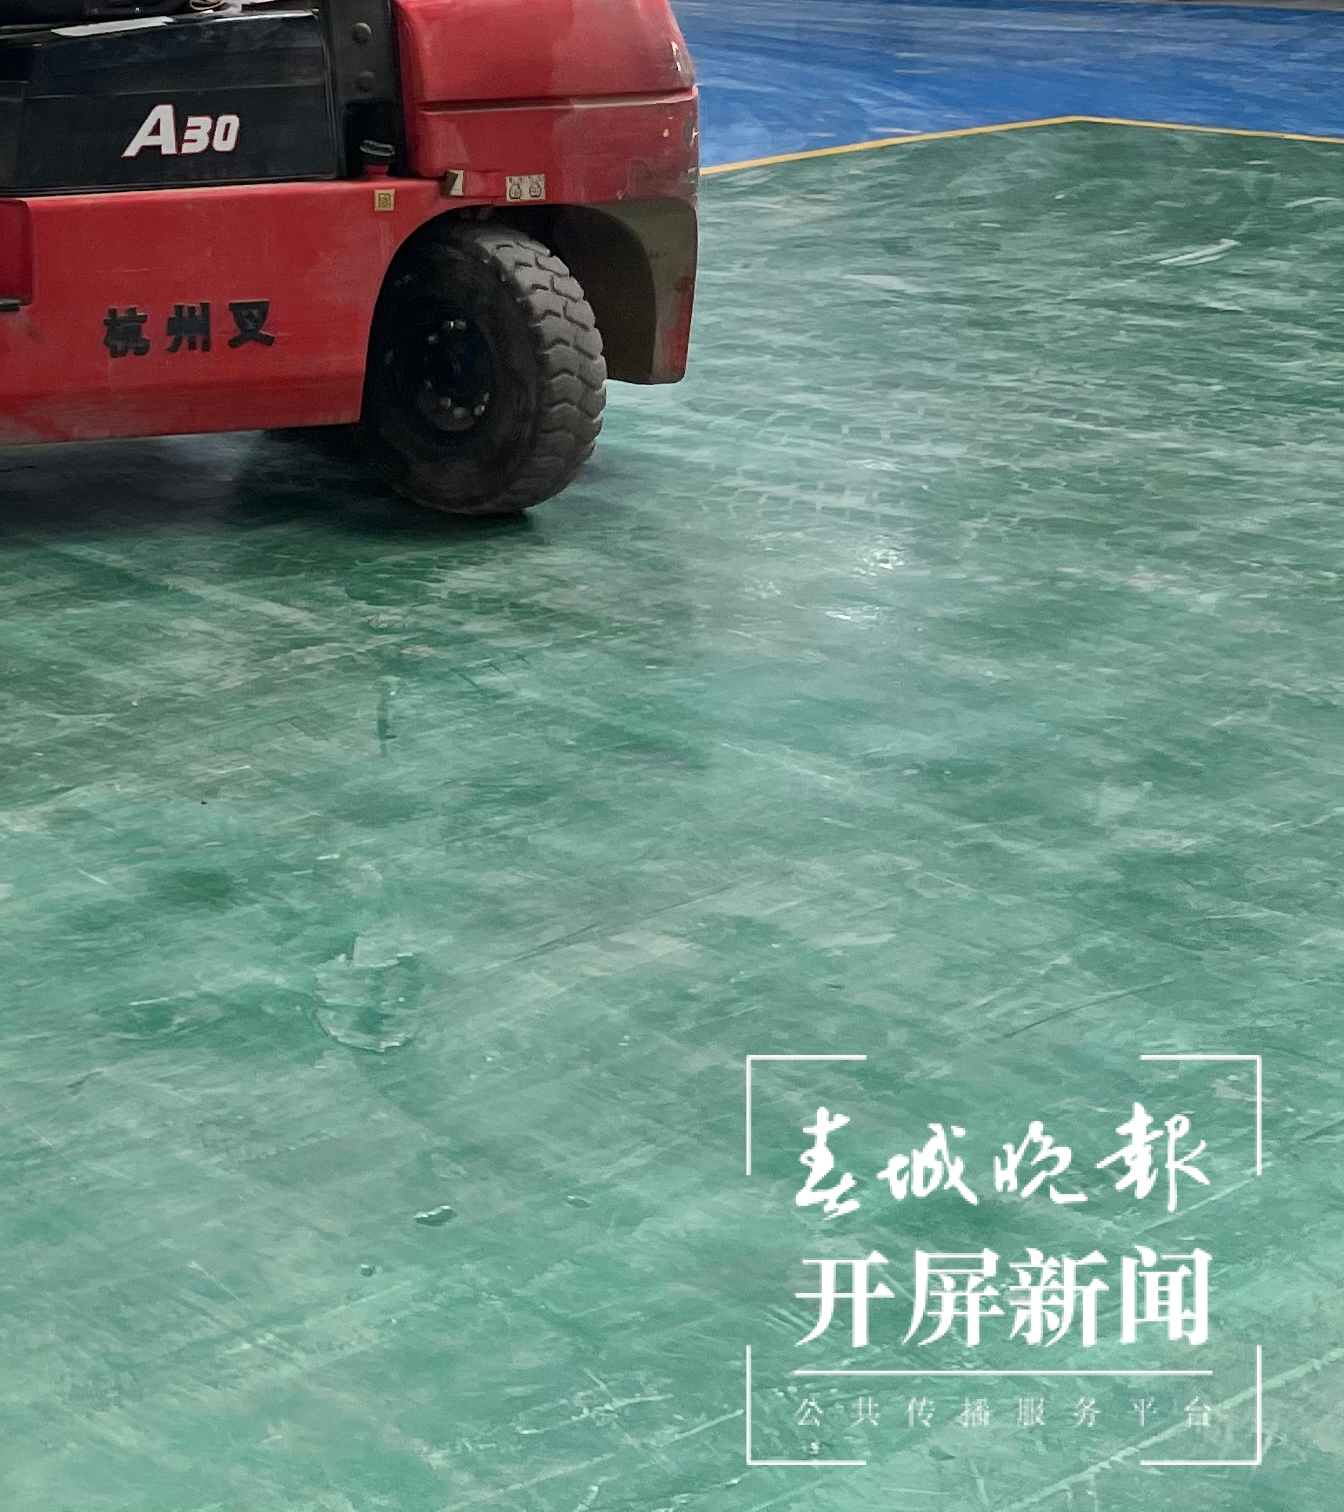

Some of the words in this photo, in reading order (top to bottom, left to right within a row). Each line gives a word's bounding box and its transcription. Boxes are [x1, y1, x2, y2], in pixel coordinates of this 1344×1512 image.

[121, 103, 241, 158] A30
[103, 300, 275, 358] 杭州叉
